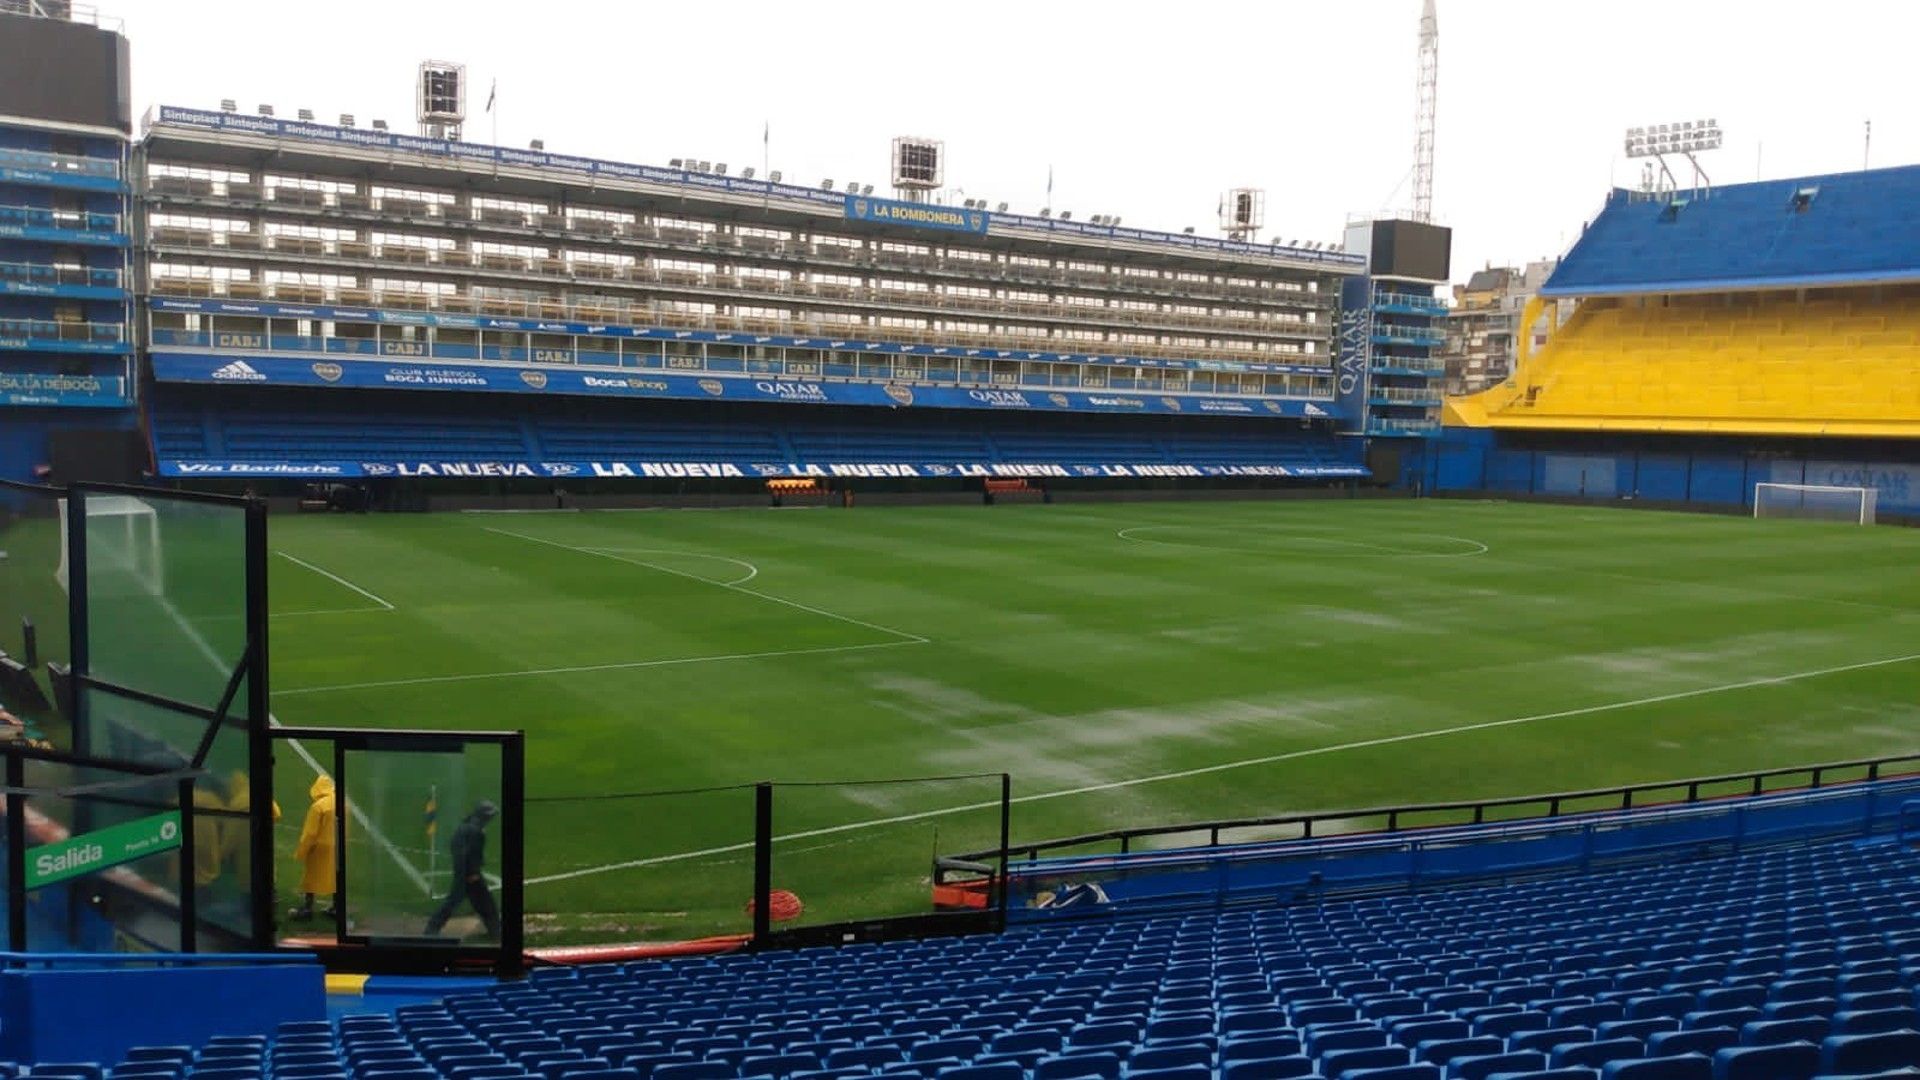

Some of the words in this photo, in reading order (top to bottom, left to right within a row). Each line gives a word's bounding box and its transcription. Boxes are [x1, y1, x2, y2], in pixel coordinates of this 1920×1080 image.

[163, 109, 220, 124] Sinteplast
[224, 116, 278, 131] Sinteplast
[285, 123, 336, 138] Sinteplast
[873, 203, 888, 217] LA
[891, 206, 965, 226] BOMBONERA
[220, 335, 262, 347] CABJ
[385, 342, 424, 355] CABJ
[1339, 309, 1359, 394] QATAR
[535, 350, 571, 362] CABJ
[669, 357, 700, 369] CABJ
[788, 363, 817, 374] CABJ
[212, 371, 267, 380] adidas
[390, 368, 422, 376] CLUB
[384, 374, 425, 383] BOCA
[428, 376, 488, 385] JUNIORS
[756, 382, 821, 395] QATAR
[969, 390, 1026, 403] QATAR
[178, 463, 223, 473] Via
[230, 463, 342, 474] Bariloche
[397, 463, 438, 476] LA
[441, 463, 536, 476] NUEVA
[591, 463, 635, 477] LA
[640, 463, 744, 477] NUEVA
[788, 464, 827, 477] LA
[830, 464, 920, 477] NUEVA
[956, 464, 989, 477] LA
[991, 464, 1071, 477] NUEVA
[1101, 465, 1134, 477] LA
[1132, 465, 1203, 477] NUEVA
[36, 844, 103, 876] Salida
